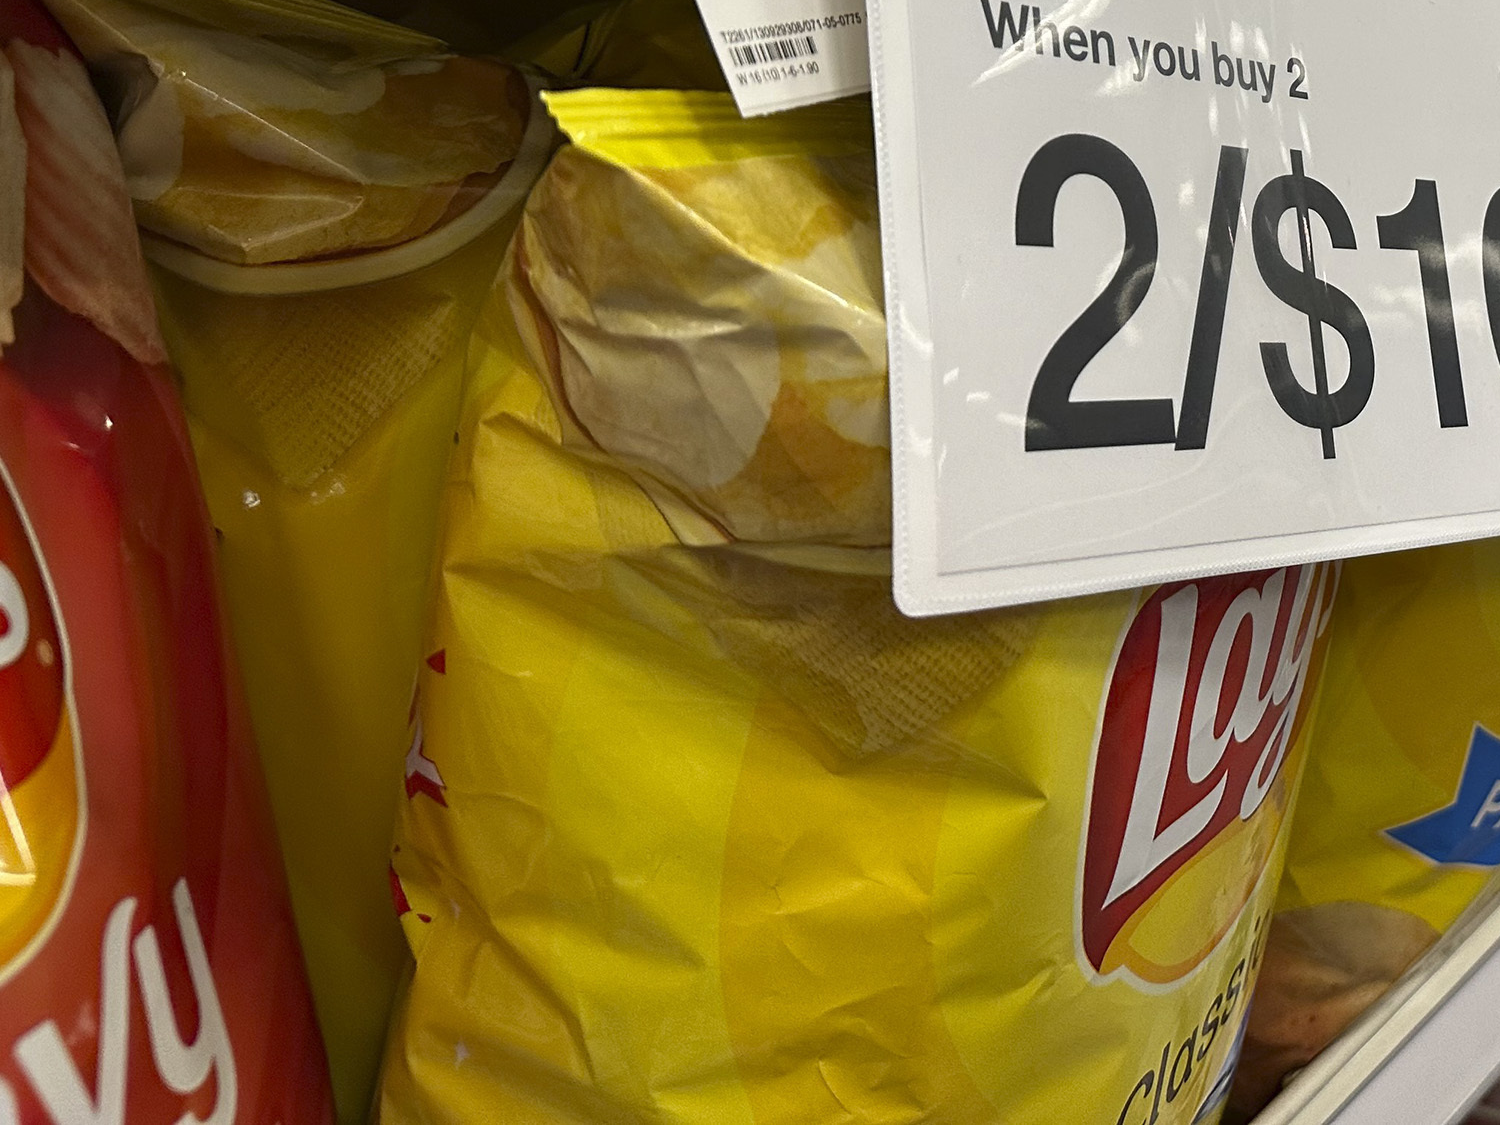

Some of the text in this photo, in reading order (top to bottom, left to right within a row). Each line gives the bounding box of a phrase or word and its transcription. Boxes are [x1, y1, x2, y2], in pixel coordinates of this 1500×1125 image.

[1126, 35, 1201, 83] you
[1210, 41, 1277, 104] buy
[1286, 56, 1311, 101] 2
